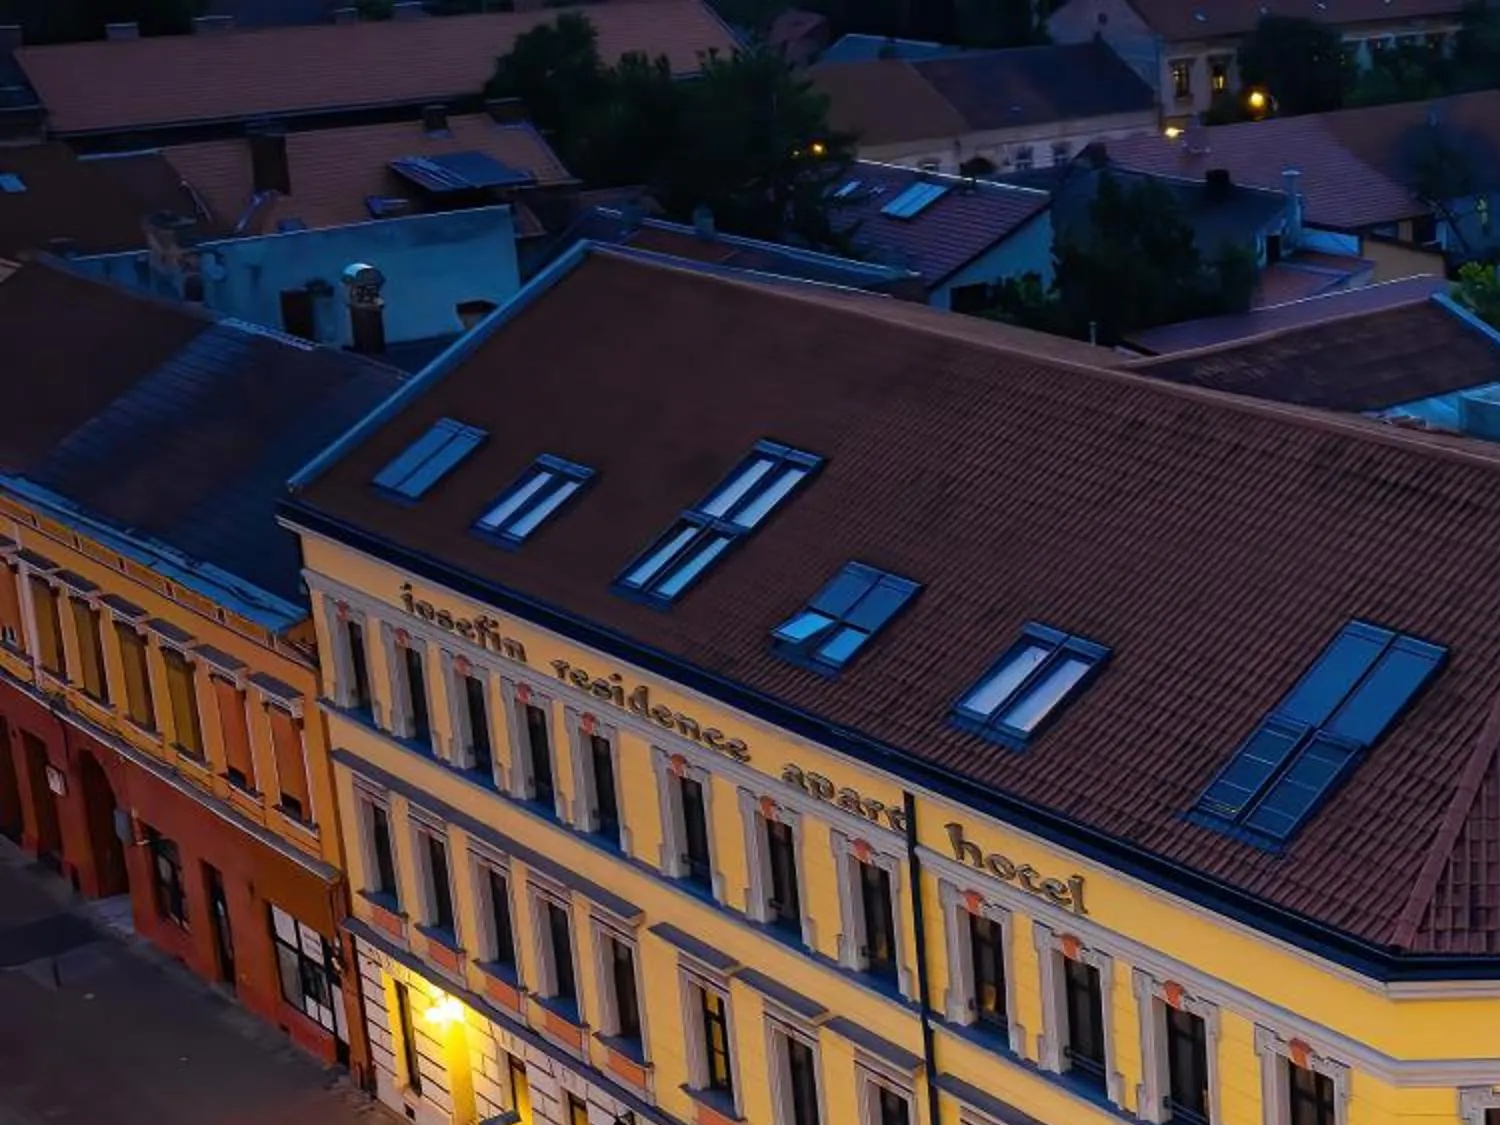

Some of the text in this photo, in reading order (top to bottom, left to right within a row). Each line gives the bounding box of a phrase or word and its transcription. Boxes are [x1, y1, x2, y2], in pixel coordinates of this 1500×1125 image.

[399, 581, 528, 662] iosefin
[550, 659, 752, 764] residence
[943, 822, 1090, 916] hotel
